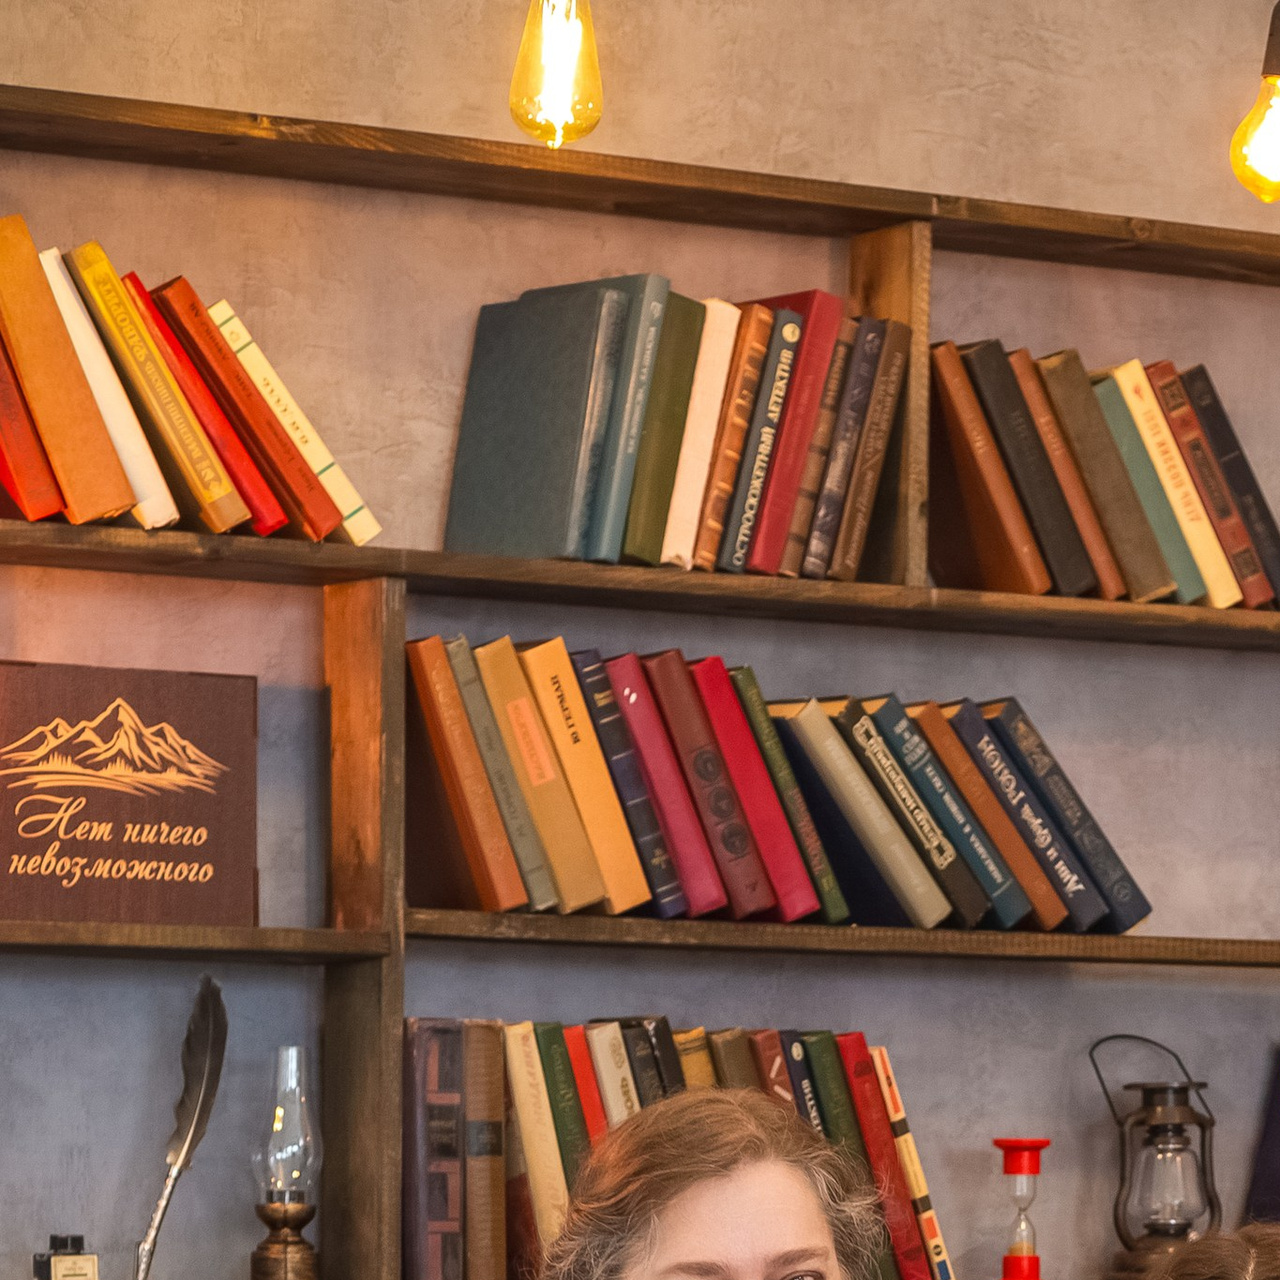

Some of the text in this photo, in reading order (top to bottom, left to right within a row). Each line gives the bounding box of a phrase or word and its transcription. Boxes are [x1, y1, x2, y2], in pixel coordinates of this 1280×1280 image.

[97, 280, 150, 363] ФАВОРИТ
[731, 348, 794, 567] ОСТРОСЮЖЕТНЫЙ ДЕТЕКТИВ
[549, 674, 575, 728] ГЕРМАН
[15, 792, 208, 848] Нет ничего
[9, 841, 215, 888] невозможного
